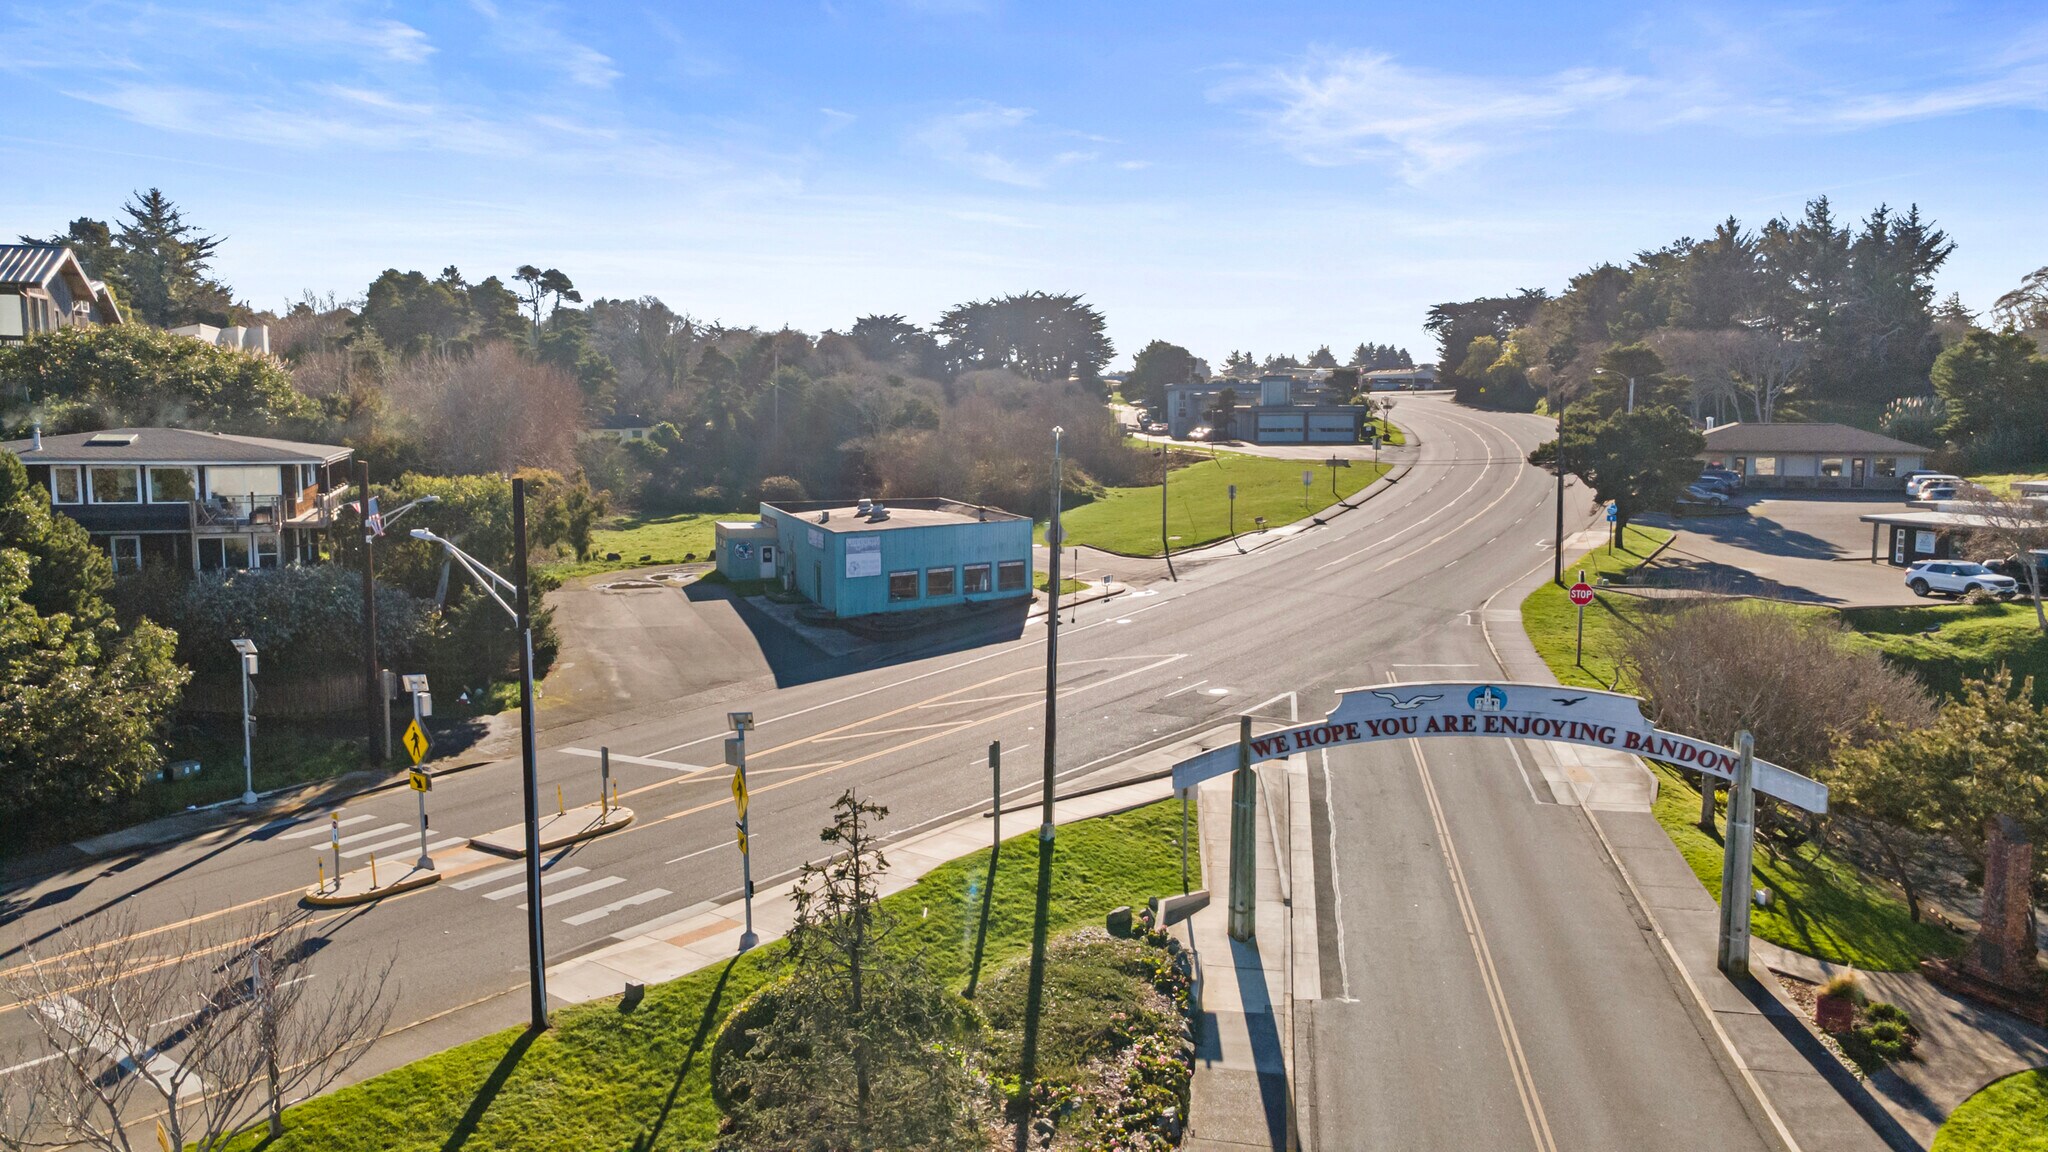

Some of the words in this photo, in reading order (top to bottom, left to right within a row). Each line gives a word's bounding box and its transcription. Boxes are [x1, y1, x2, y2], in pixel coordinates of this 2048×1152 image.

[1571, 590, 1592, 599] STOP
[1250, 735, 1290, 758] WE
[1293, 722, 1361, 749] HOPE
[1365, 716, 1418, 737] YOU
[1425, 715, 1477, 733] ARE
[1483, 715, 1616, 745] ENJOYING
[1623, 731, 1740, 775] BANDON
